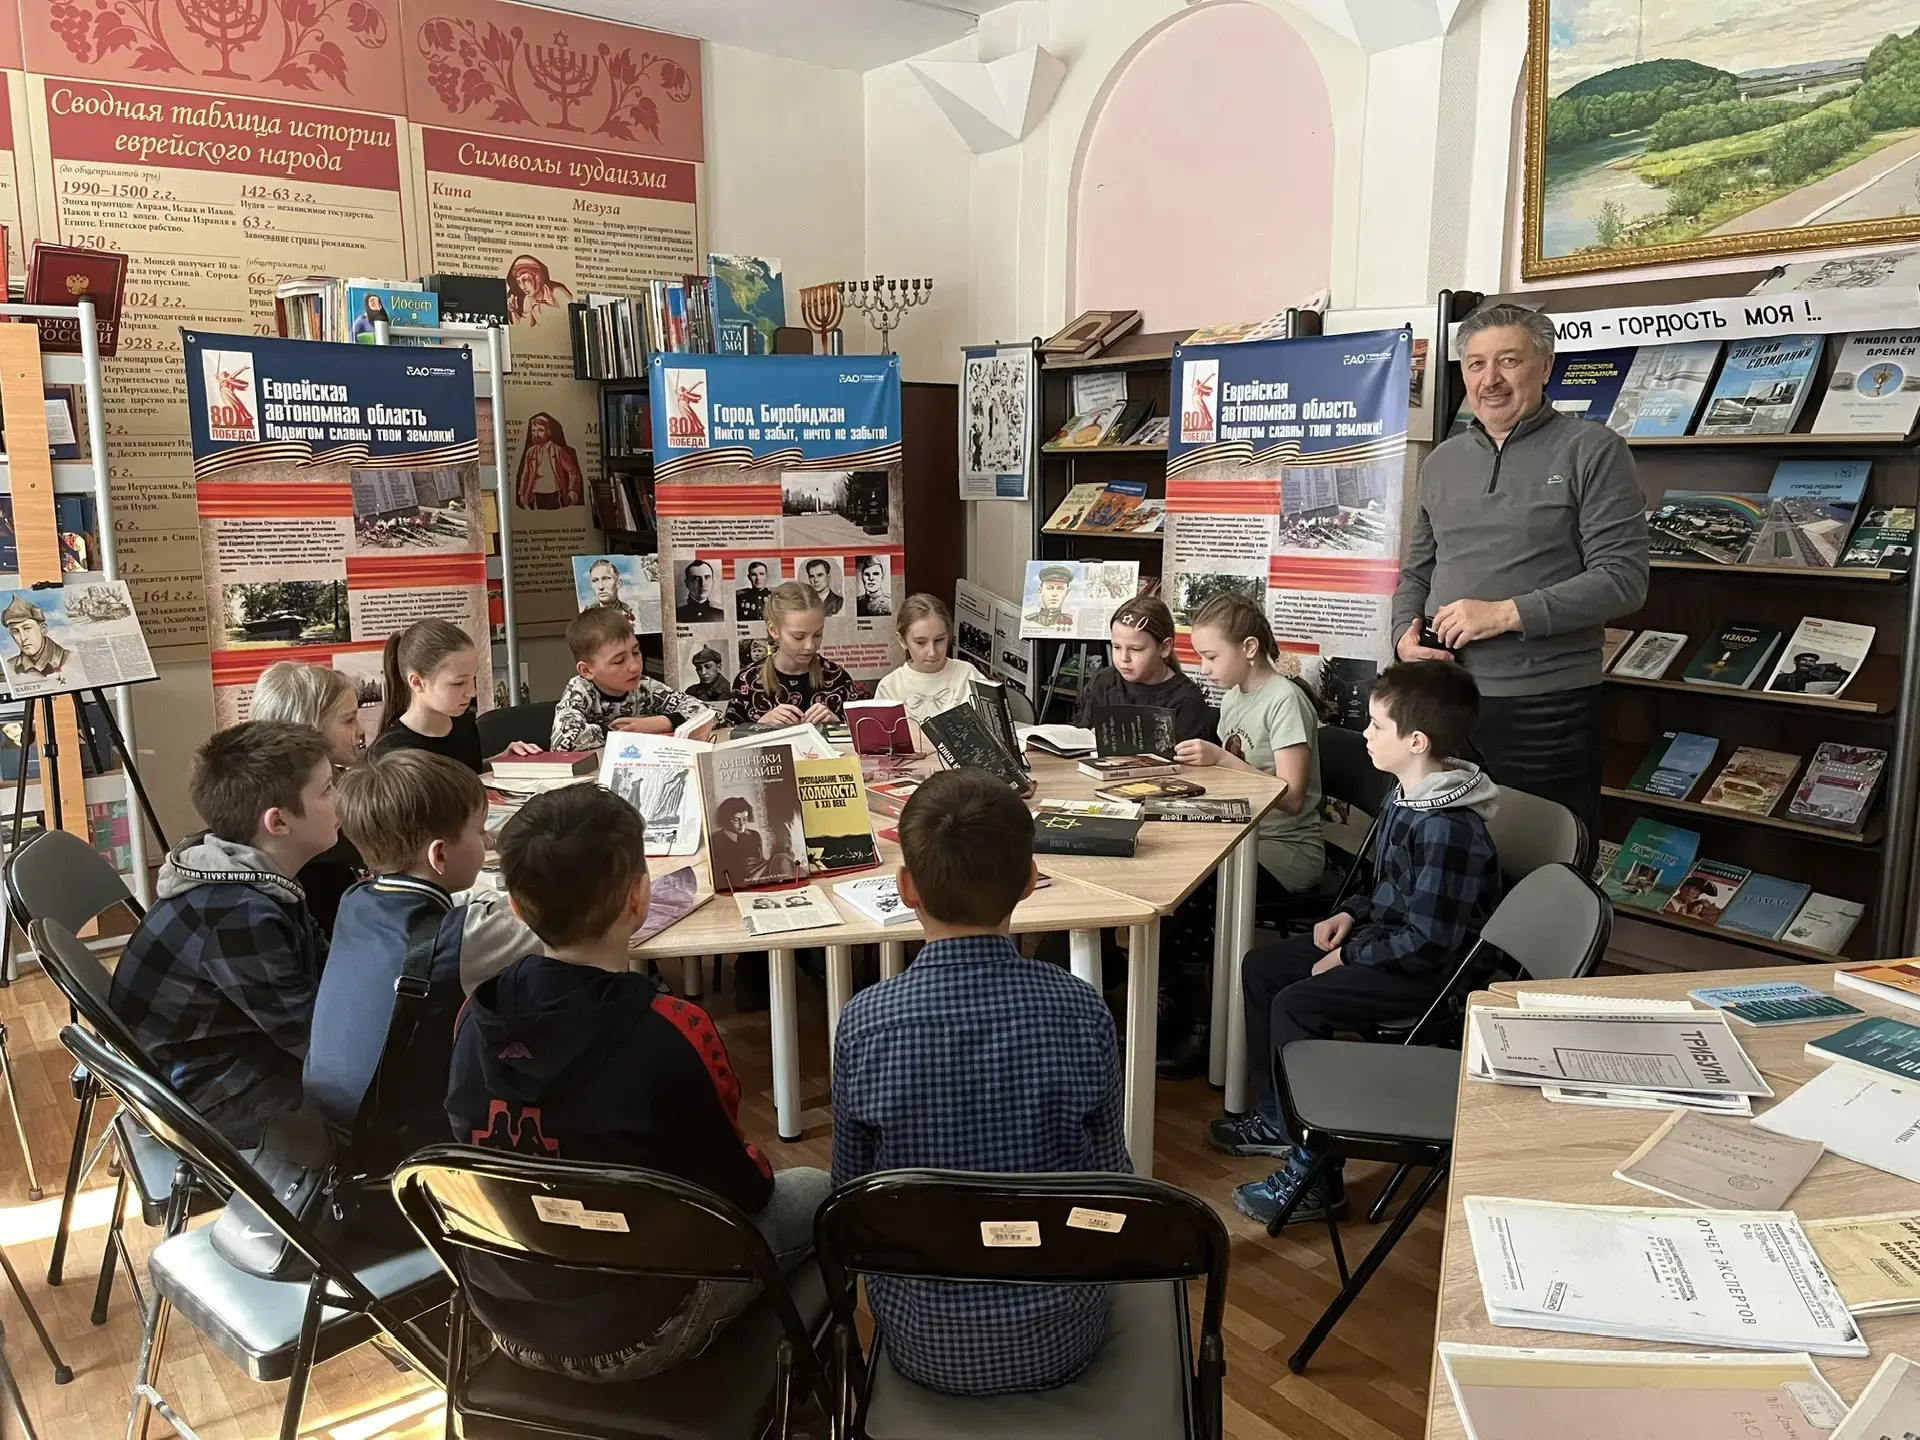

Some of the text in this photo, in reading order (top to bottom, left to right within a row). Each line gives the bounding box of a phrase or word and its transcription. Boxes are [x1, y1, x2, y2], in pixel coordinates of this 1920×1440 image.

[51, 88, 392, 151] Сводная таблица истории
[115, 134, 342, 174] еврейского народа
[75, 166, 139, 178] общепринятой
[457, 143, 668, 189] Символы иудаизма
[152, 191, 176, 201] г.г.
[294, 194, 316, 203] г.г.
[432, 182, 472, 199] Кипа
[62, 197, 89, 207] Эпоха
[172, 204, 198, 214] Исаак
[240, 200, 375, 219] Иудея независимое государство.
[433, 202, 452, 211] Кипа
[464, 207, 503, 216] небольшая
[572, 199, 620, 216] Мезуза
[63, 208, 92, 217] Иаков
[102, 211, 116, 220] его
[118, 211, 128, 219] 12
[164, 214, 191, 223] Сыны
[193, 215, 229, 226] Израиля
[242, 216, 260, 229] 63
[433, 211, 492, 224] Ортодоксальные
[573, 218, 594, 226] Мезуза
[99, 219, 147, 230] Египетское
[149, 222, 184, 232] рабство.
[67, 234, 105, 250] 1250
[243, 231, 289, 244] Завоевание
[291, 235, 320, 247] страны
[144, 258, 176, 266] Моисей
[178, 260, 215, 269] получает
[148, 269, 167, 277] горе
[391, 295, 432, 312] Иосиф
[134, 313, 197, 324] руководителей
[1555, 321, 1592, 341] МОЯ
[1619, 310, 1727, 337] ГОРДОСТЬ
[1744, 304, 1794, 326] МОЯ
[1853, 336, 1897, 344] ЖИВАЯ
[1731, 342, 1782, 360] ЭНЕРГИЯ
[1746, 348, 1813, 370] СОЗИДАНИЯ
[1866, 346, 1916, 356] ВРЕМЁН
[124, 356, 164, 365] монархов
[104, 365, 151, 376] Иерусалим
[1564, 370, 1618, 378] АВТОНОМНАЯ
[104, 376, 170, 386] Строительство
[262, 377, 348, 404] Еврейская
[1222, 380, 1289, 406] Еврейская
[130, 397, 164, 406] царство
[265, 403, 427, 427] автономная область
[714, 403, 845, 427] Город Биробиджан
[1221, 398, 1357, 423] автономная область
[210, 405, 257, 441] 80 ПОБЕДА!
[1182, 411, 1214, 442] 80 ПОБЕДА!
[1221, 419, 1383, 441] Подвигом славны твои земляки!
[266, 423, 455, 443] Подвигом славны твои земляки!
[669, 417, 707, 448] 80 ПОБЕДА!
[714, 425, 888, 442] Никто не забыт, ничто не забыто!
[117, 451, 147, 459] Десять
[130, 575, 174, 585] присягает
[146, 627, 177, 636] Ханука
[1721, 633, 1758, 644] ИЗКОР
[718, 753, 782, 770] ДНЕВНИКИ
[720, 763, 783, 782] РУТ МАЙЕР
[839, 774, 854, 782] ТЕМЫ
[800, 784, 857, 800] ХОЛОКОСТА
[815, 800, 820, 808] В
[833, 799, 846, 808] ВЕКЕ
[202, 872, 227, 880] SKATE
[228, 872, 255, 881] URBAN
[1680, 1031, 1731, 1084] ТРИБУНА
[1696, 1219, 1757, 1325] ОТЧЕТ ЭКСПЕРТОВ
